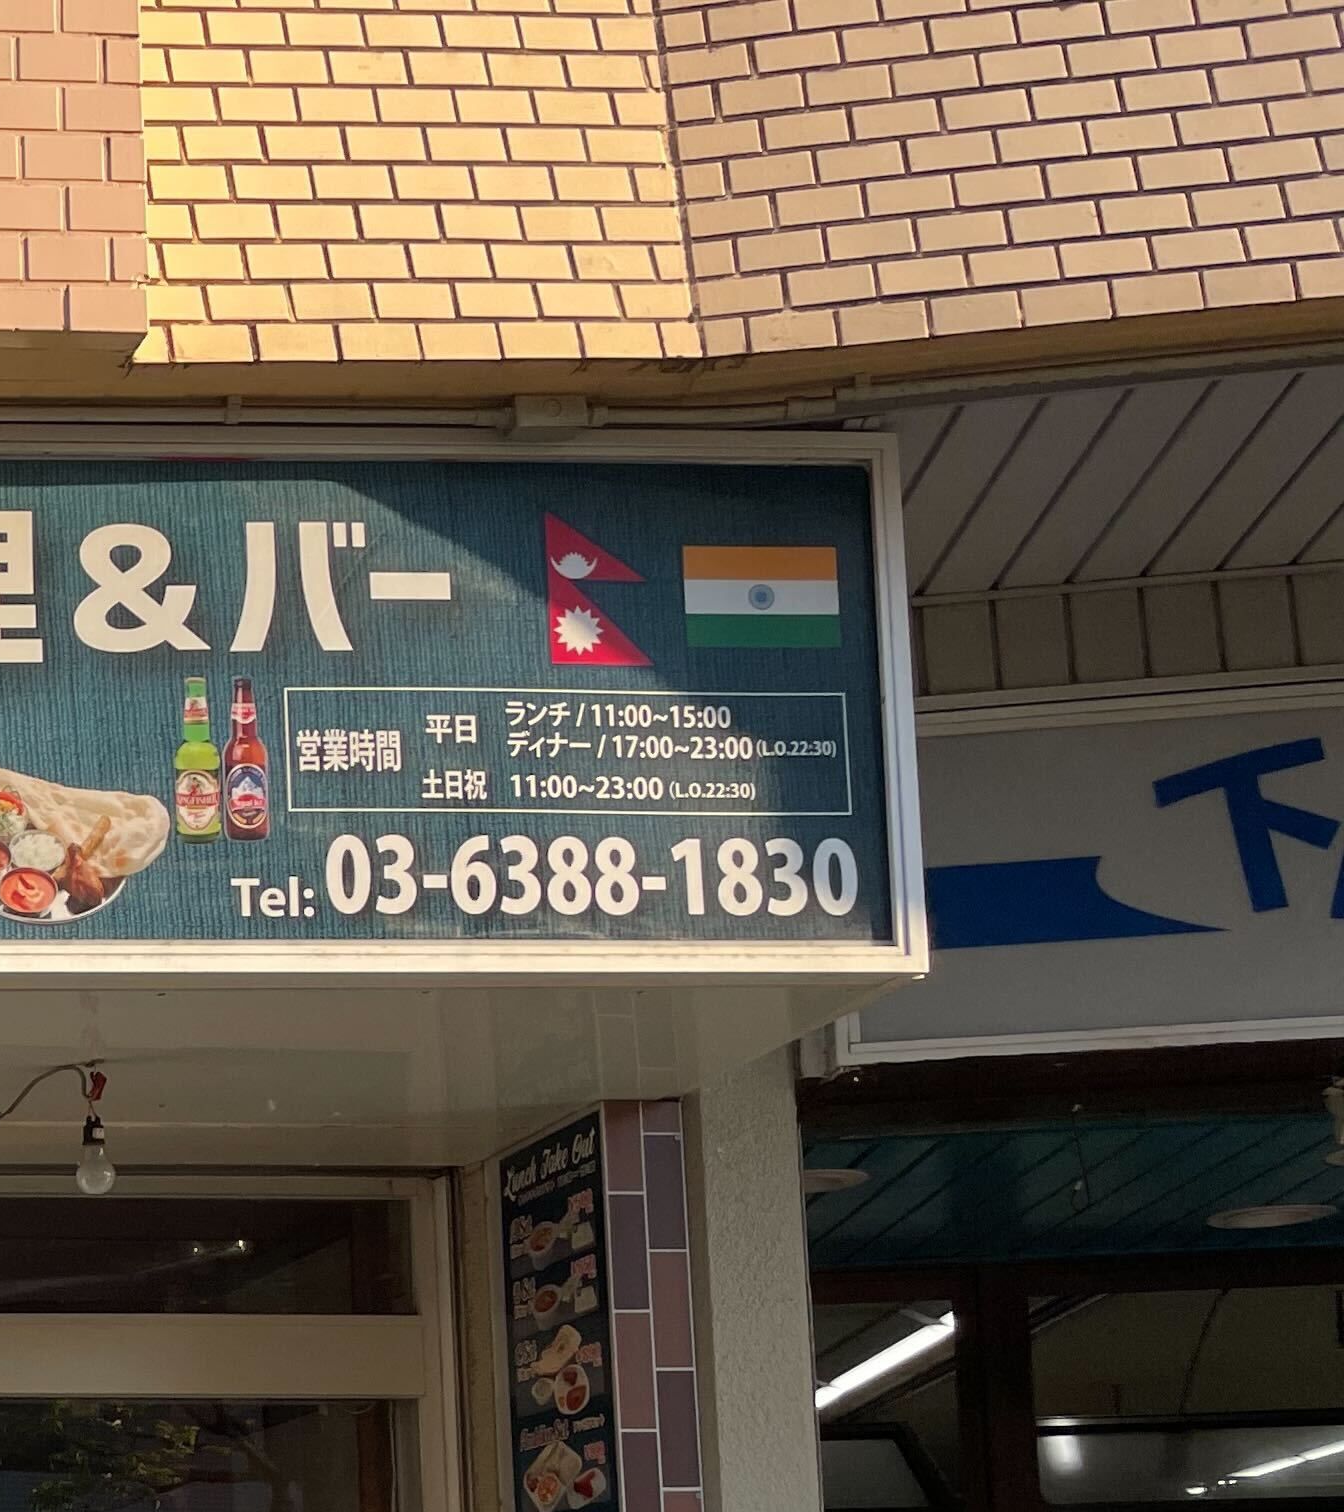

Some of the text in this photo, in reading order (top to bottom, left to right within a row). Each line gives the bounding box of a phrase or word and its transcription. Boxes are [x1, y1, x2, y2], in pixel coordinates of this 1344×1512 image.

[73, 522, 208, 654] &
[231, 520, 452, 654] バー
[425, 701, 732, 744] 平日 ランチ 11:00~15:00
[296, 729, 403, 773] 営業時間
[506, 734, 592, 759] ディナー
[611, 736, 754, 762] 17:00~23:00
[422, 770, 488, 800] 土日祝
[510, 775, 663, 800] 11:00~23:00
[231, 833, 858, 919] Tel: 03-6388-1830
